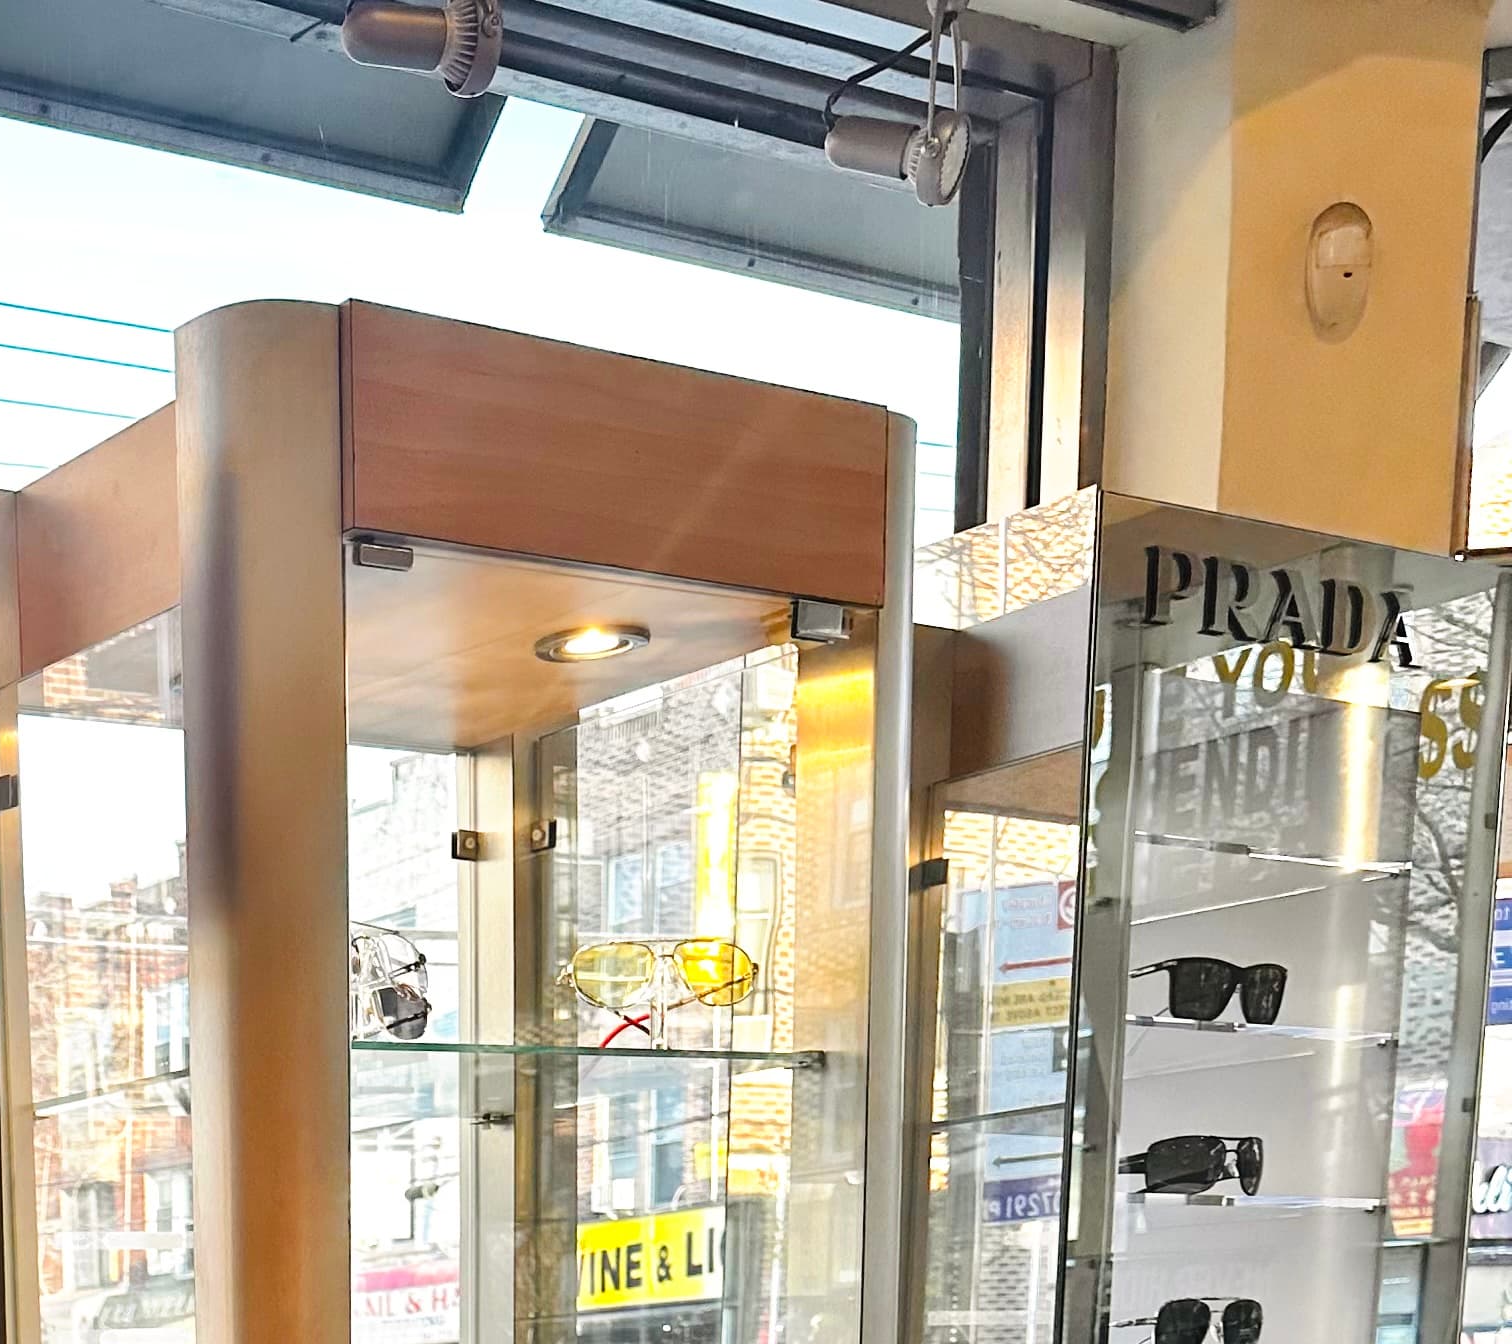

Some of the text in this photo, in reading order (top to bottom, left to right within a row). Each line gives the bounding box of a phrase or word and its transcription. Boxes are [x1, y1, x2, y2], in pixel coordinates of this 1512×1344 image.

[1140, 545, 1422, 669] PRADA
[577, 1227, 726, 1297] INE & LI
